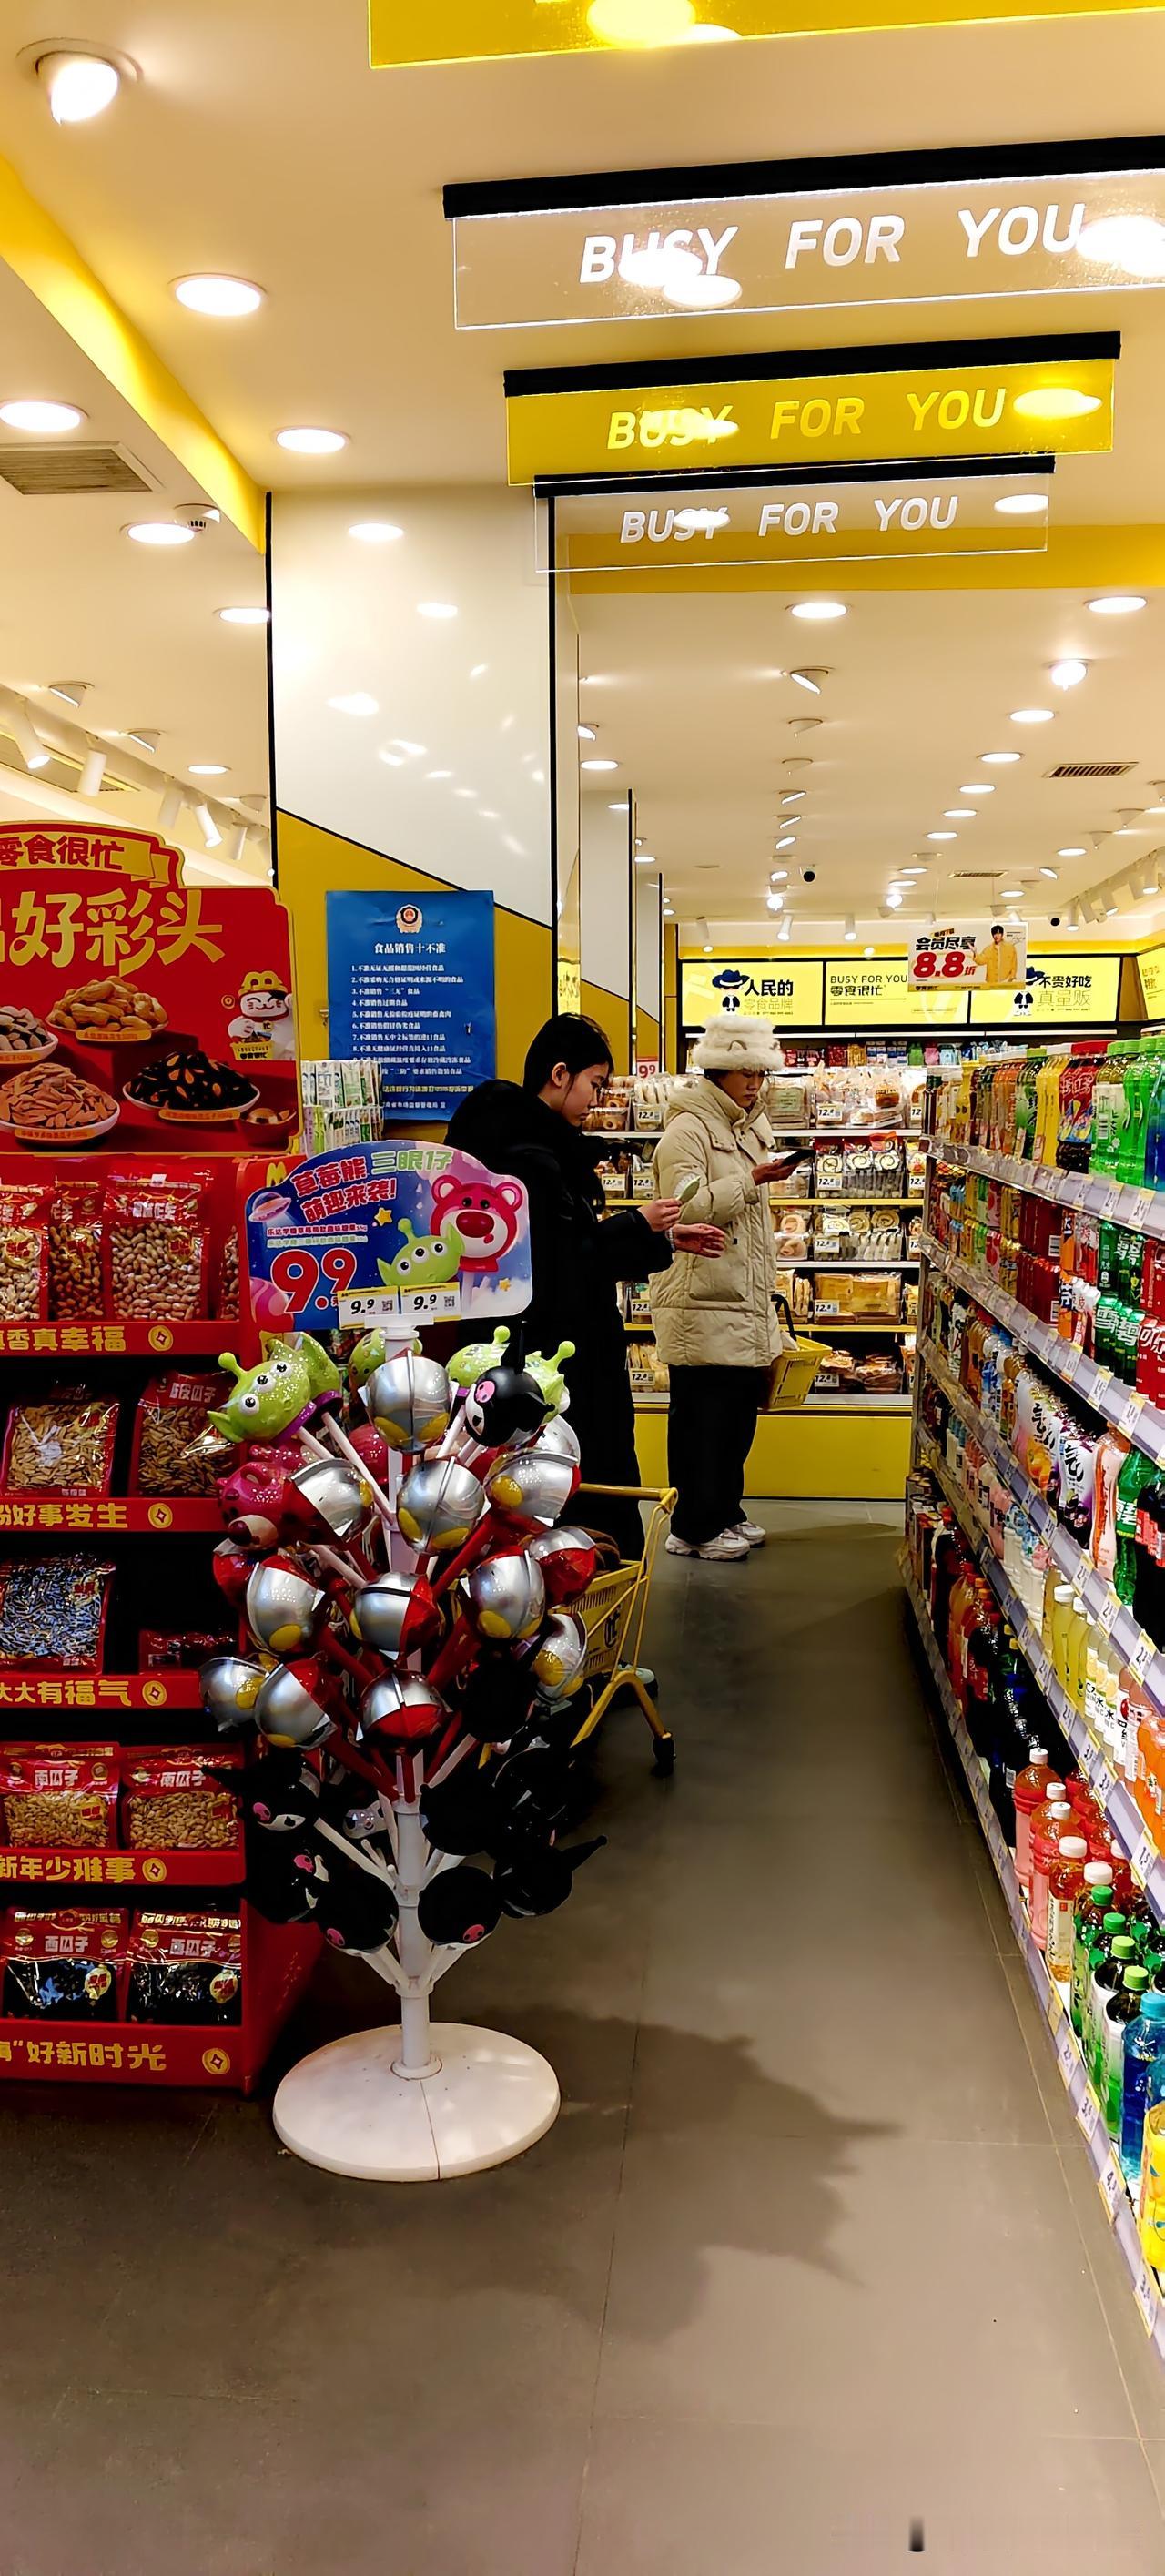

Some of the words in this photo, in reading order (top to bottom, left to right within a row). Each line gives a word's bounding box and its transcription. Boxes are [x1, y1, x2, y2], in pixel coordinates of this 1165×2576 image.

[785, 215, 907, 269] FOR
[957, 203, 1086, 259] YOU
[606, 404, 733, 450] BUSY
[769, 396, 866, 441] FOR
[906, 387, 1007, 430] YOU
[620, 507, 728, 544] BUSY
[758, 502, 840, 537] FOR
[873, 495, 958, 532] YOU
[0, 888, 226, 977] 好彩头
[374, 942, 446, 954] 食品销售十不准
[916, 936, 977, 950] 会员尽享
[830, 975, 857, 983] BUSY
[861, 975, 883, 983] FOR
[886, 974, 907, 983] YOU
[1039, 975, 1092, 989] 不贵好吃
[745, 979, 794, 997] 人民的
[830, 985, 883, 997] 零食很忙
[744, 998, 794, 1012] 零食品牌
[291, 1156, 367, 1198] 草莓熊
[370, 1149, 454, 1176] 三眼仔
[350, 1298, 375, 1314] 9.9
[413, 1294, 437, 1310] 9.9
[0, 1325, 126, 1352] 香真幸福
[35, 1769, 79, 1787] 南瓜子
[160, 1770, 207, 1788] 南瓜子
[0, 1855, 136, 1883] 新年少难事
[45, 1935, 88, 1952] 西瓜子
[169, 1938, 217, 1956] 西瓜子
